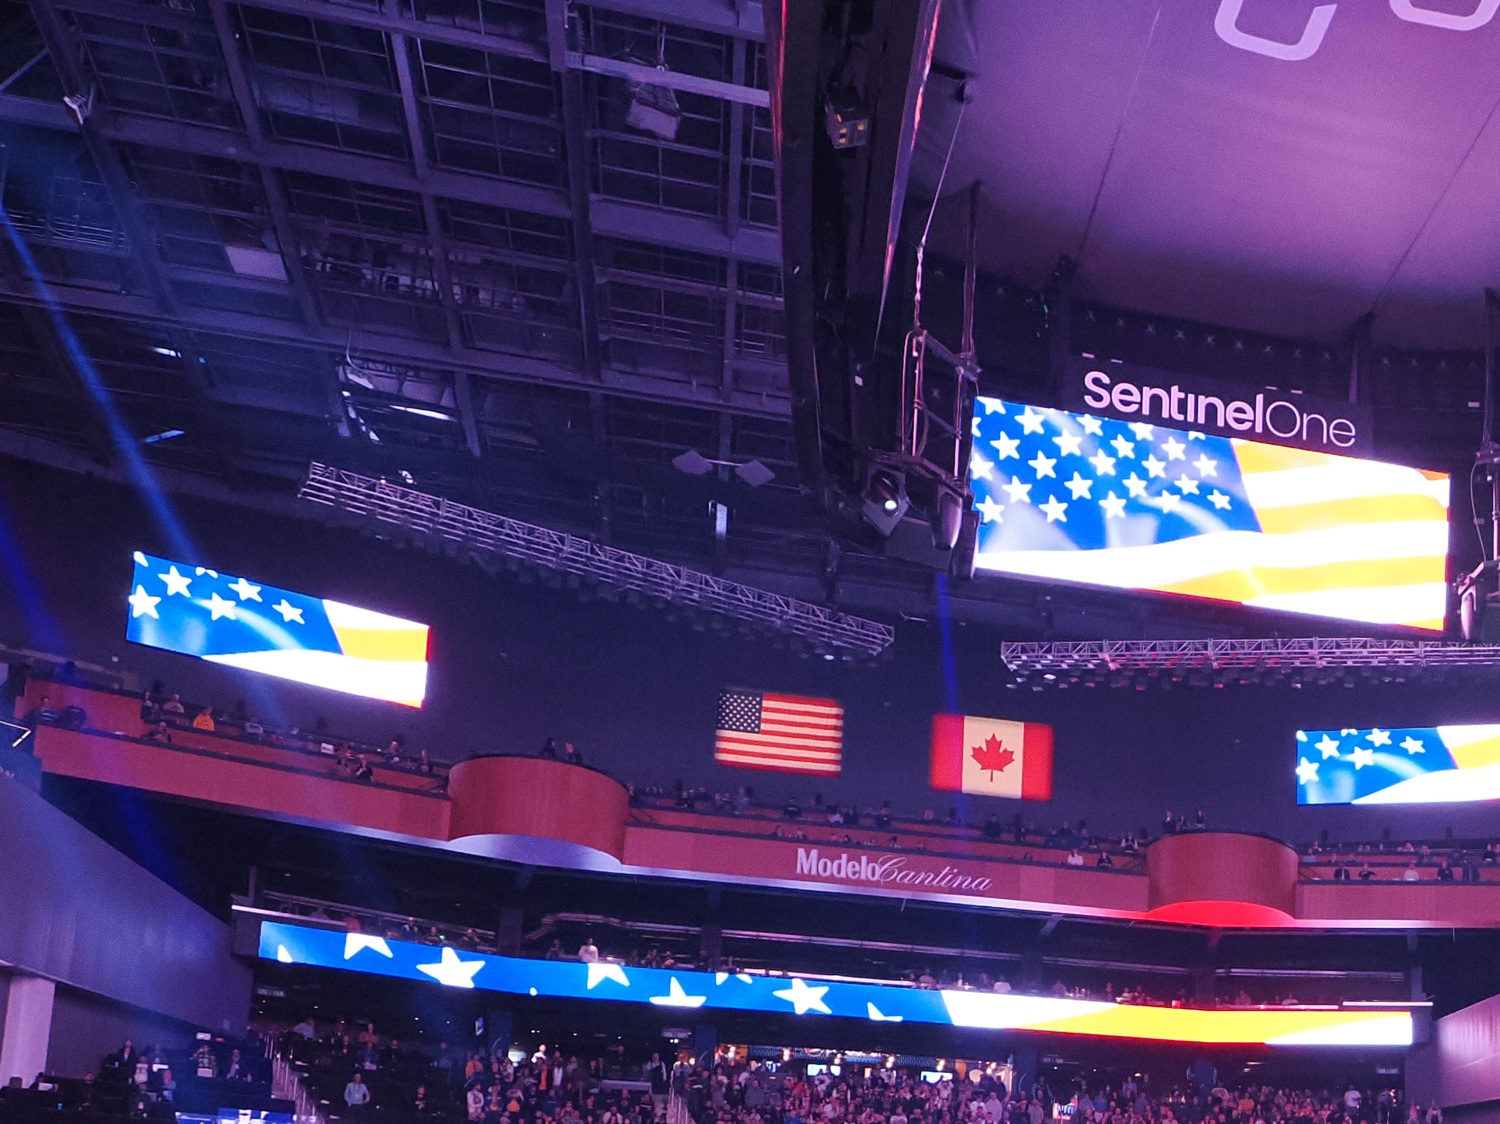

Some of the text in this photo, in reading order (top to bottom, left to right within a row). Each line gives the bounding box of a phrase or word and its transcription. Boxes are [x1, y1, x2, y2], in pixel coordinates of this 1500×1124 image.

[1084, 371, 1356, 447] SentinelOne
[796, 848, 993, 891] Modelo Cantina
